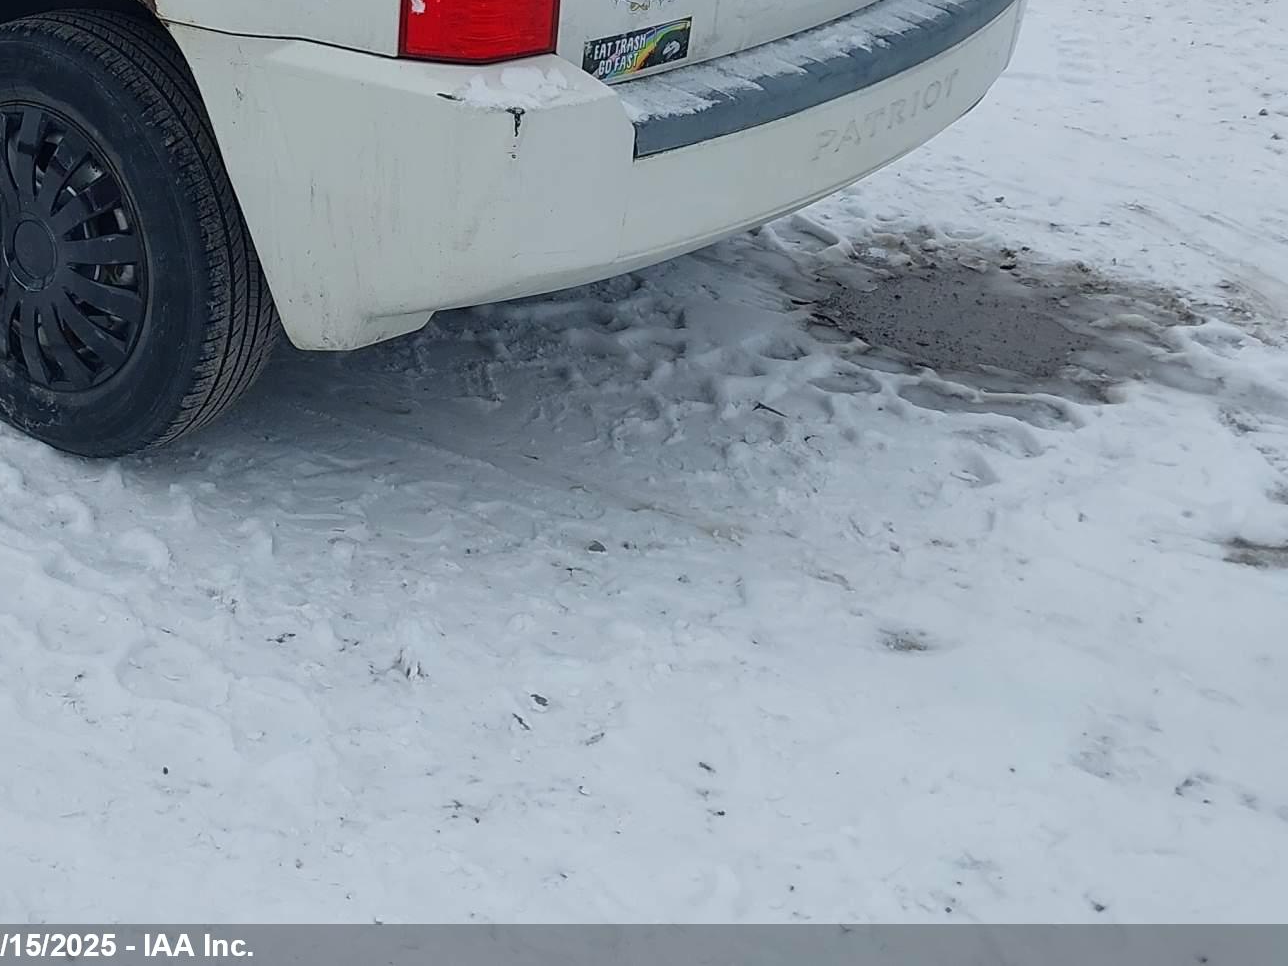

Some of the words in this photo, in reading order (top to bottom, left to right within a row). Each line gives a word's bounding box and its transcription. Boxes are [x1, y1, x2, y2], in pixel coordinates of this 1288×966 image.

[594, 42, 614, 60] EAT
[615, 33, 648, 54] TRASH
[598, 61, 612, 76] GO
[614, 52, 640, 72] FAST
[810, 68, 961, 162] PATRIOT
